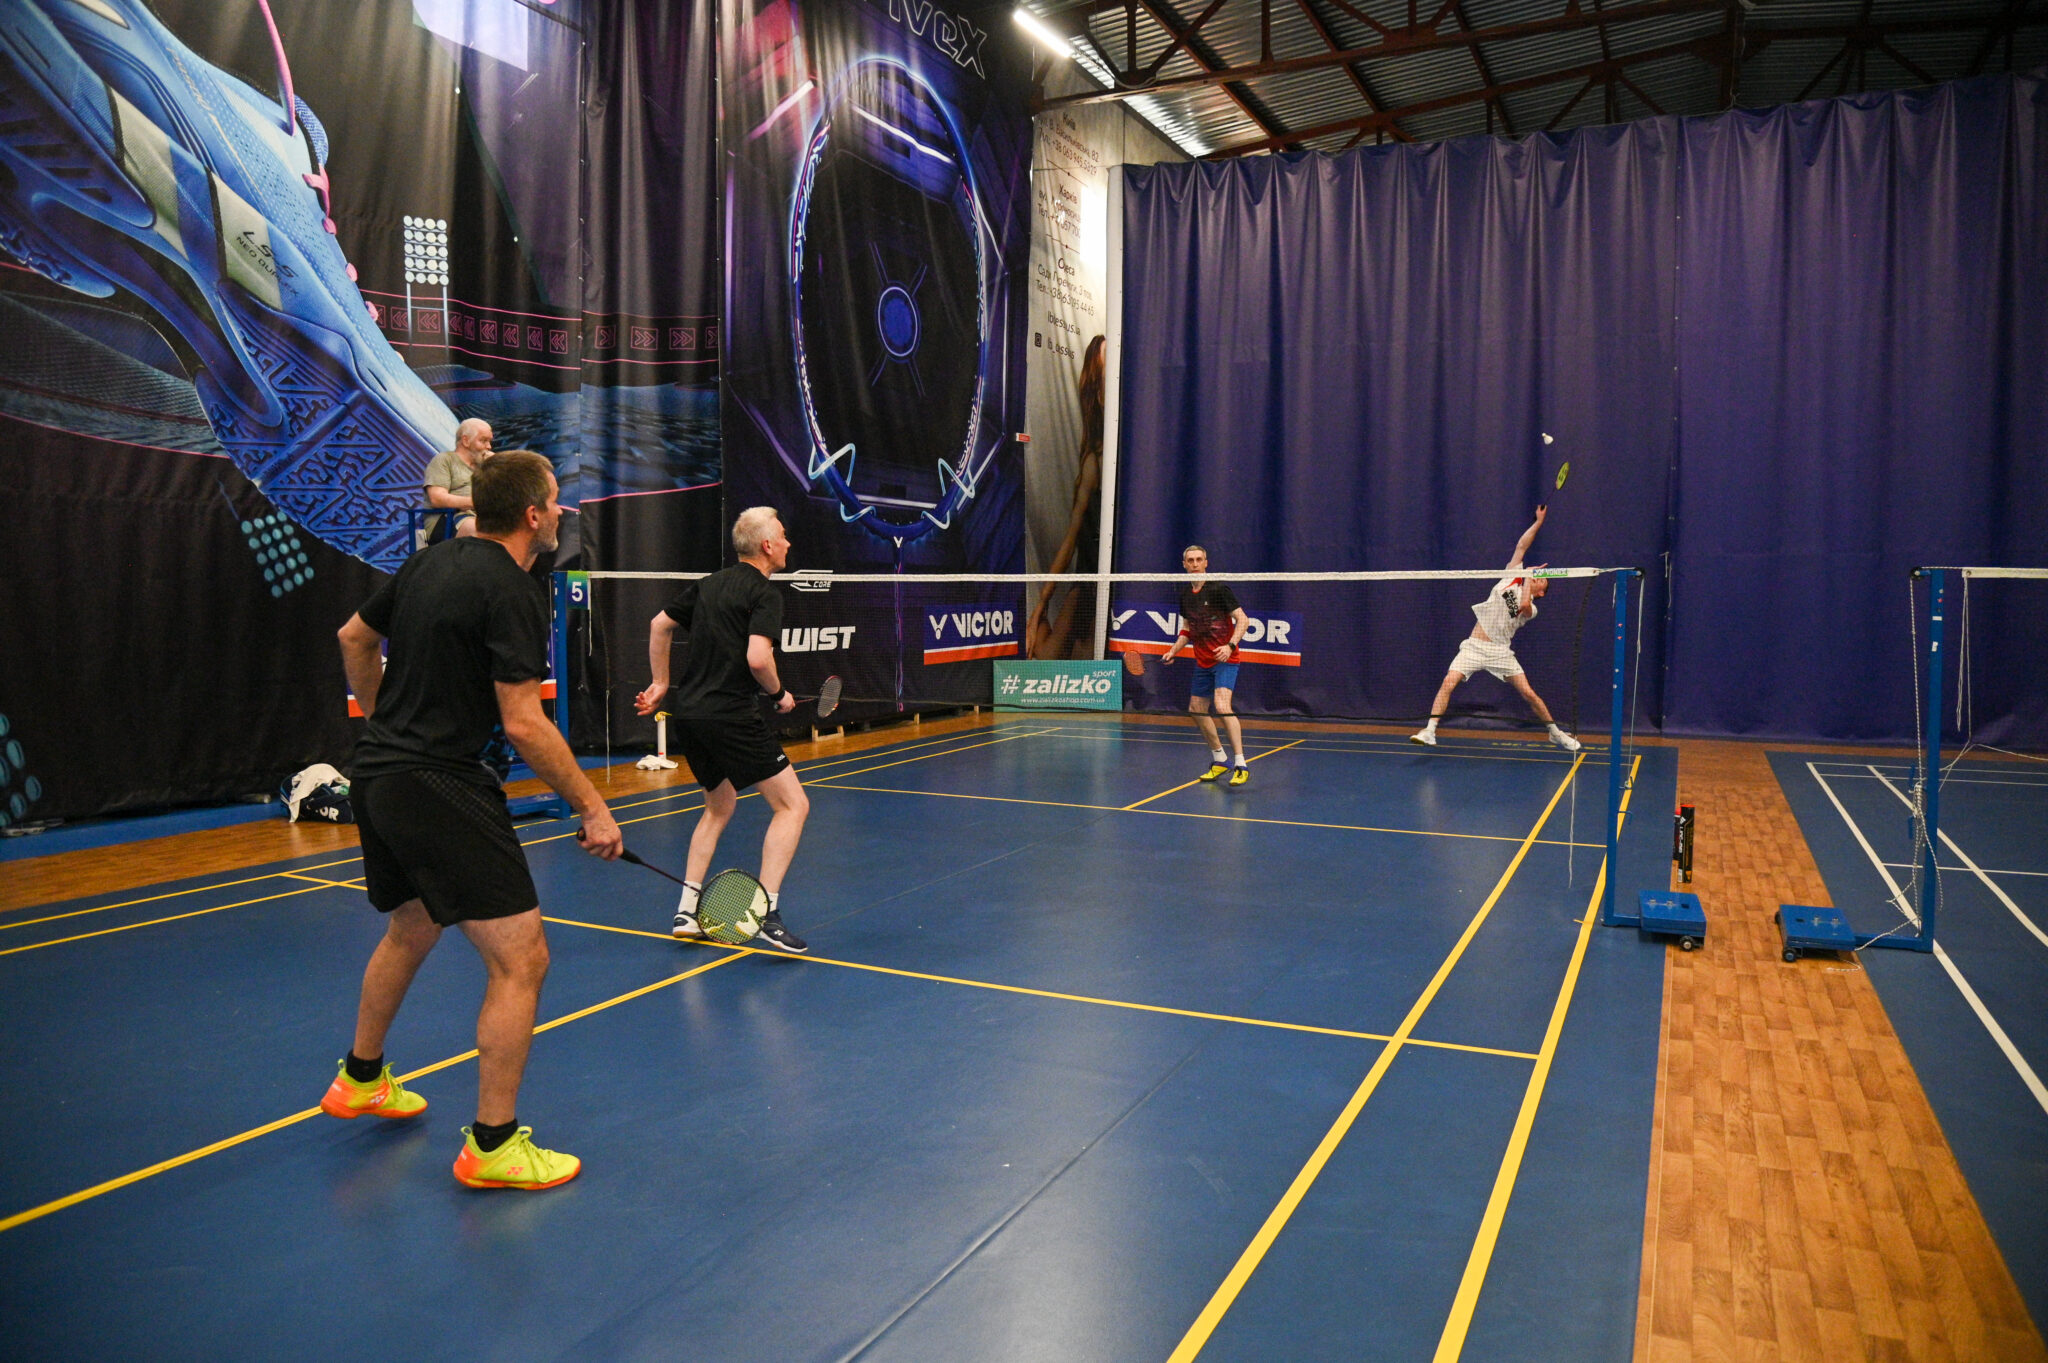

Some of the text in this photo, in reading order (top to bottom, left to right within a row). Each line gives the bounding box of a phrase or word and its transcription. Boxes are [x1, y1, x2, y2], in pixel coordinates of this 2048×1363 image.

[236, 236, 258, 259] NEO
[571, 581, 584, 602] 5
[951, 610, 1014, 638] VICTOR
[1145, 610, 1292, 645] VIOR
[781, 626, 856, 653] WIST
[1092, 670, 1117, 679] sport
